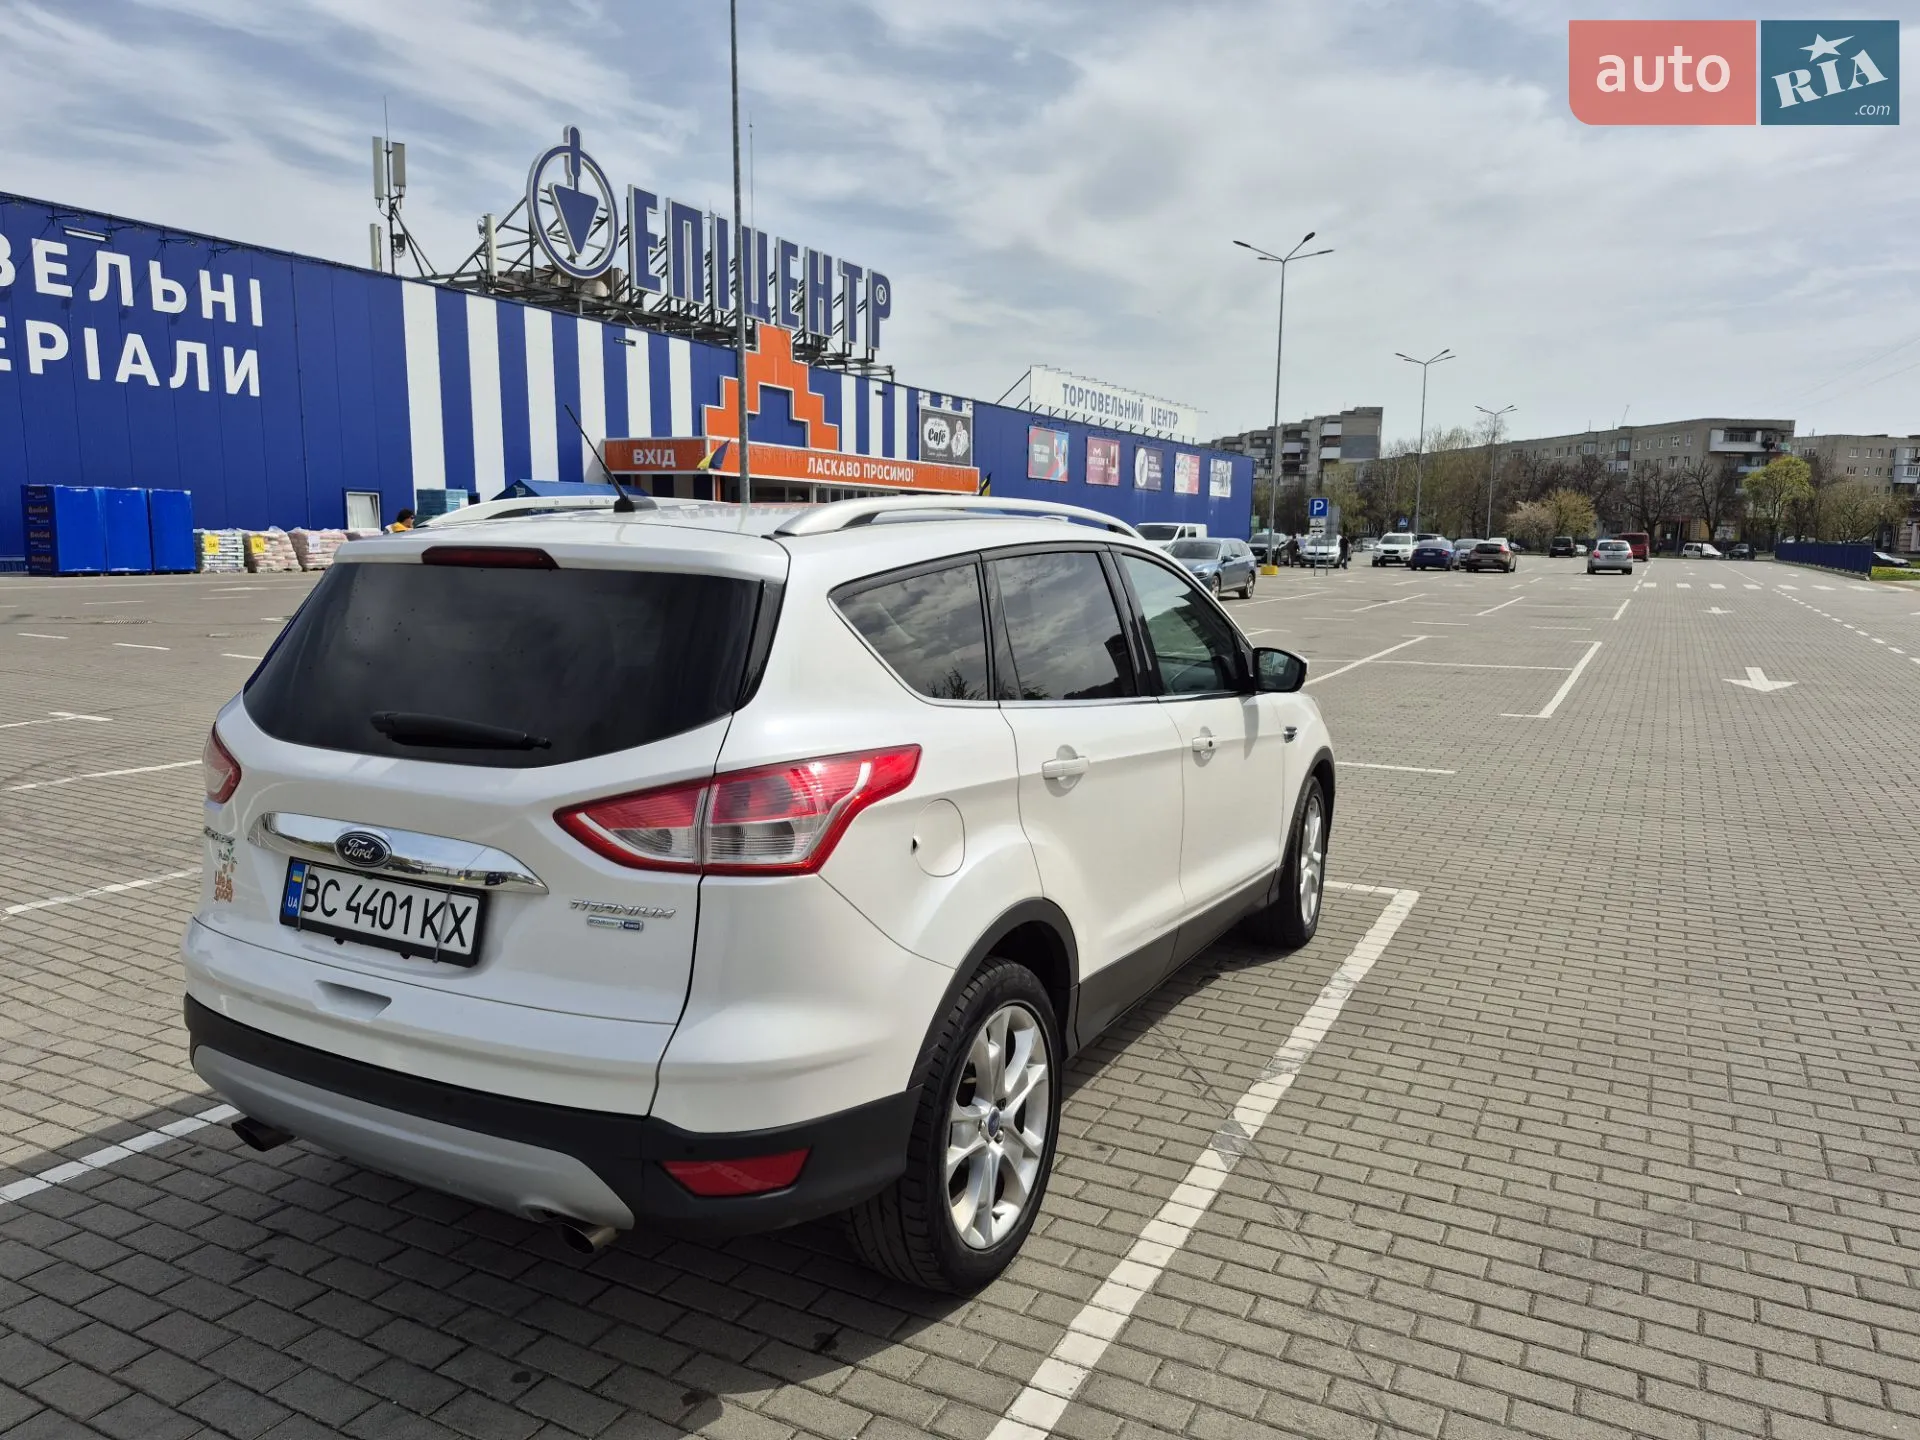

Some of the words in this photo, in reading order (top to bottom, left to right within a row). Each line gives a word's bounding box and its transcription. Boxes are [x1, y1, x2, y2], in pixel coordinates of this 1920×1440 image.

[628, 184, 892, 351] ЕПІЦЕНТР
[0, 316, 260, 397] РІАЛИ
[1062, 383, 1144, 422] ТОРГОВЕЛЬНИЙ
[1151, 406, 1179, 429] ЦЕНТР
[632, 448, 677, 468] ВХІД
[807, 457, 861, 478] ЛАСКАВО
[863, 463, 914, 483] ПРОСИМО!
[1313, 500, 1324, 515] P
[344, 838, 375, 860] Ford
[287, 896, 298, 909] UA
[302, 874, 341, 917] BC
[345, 884, 414, 935] 4401
[420, 898, 472, 947] KX
[570, 899, 676, 919] TITANIUM
